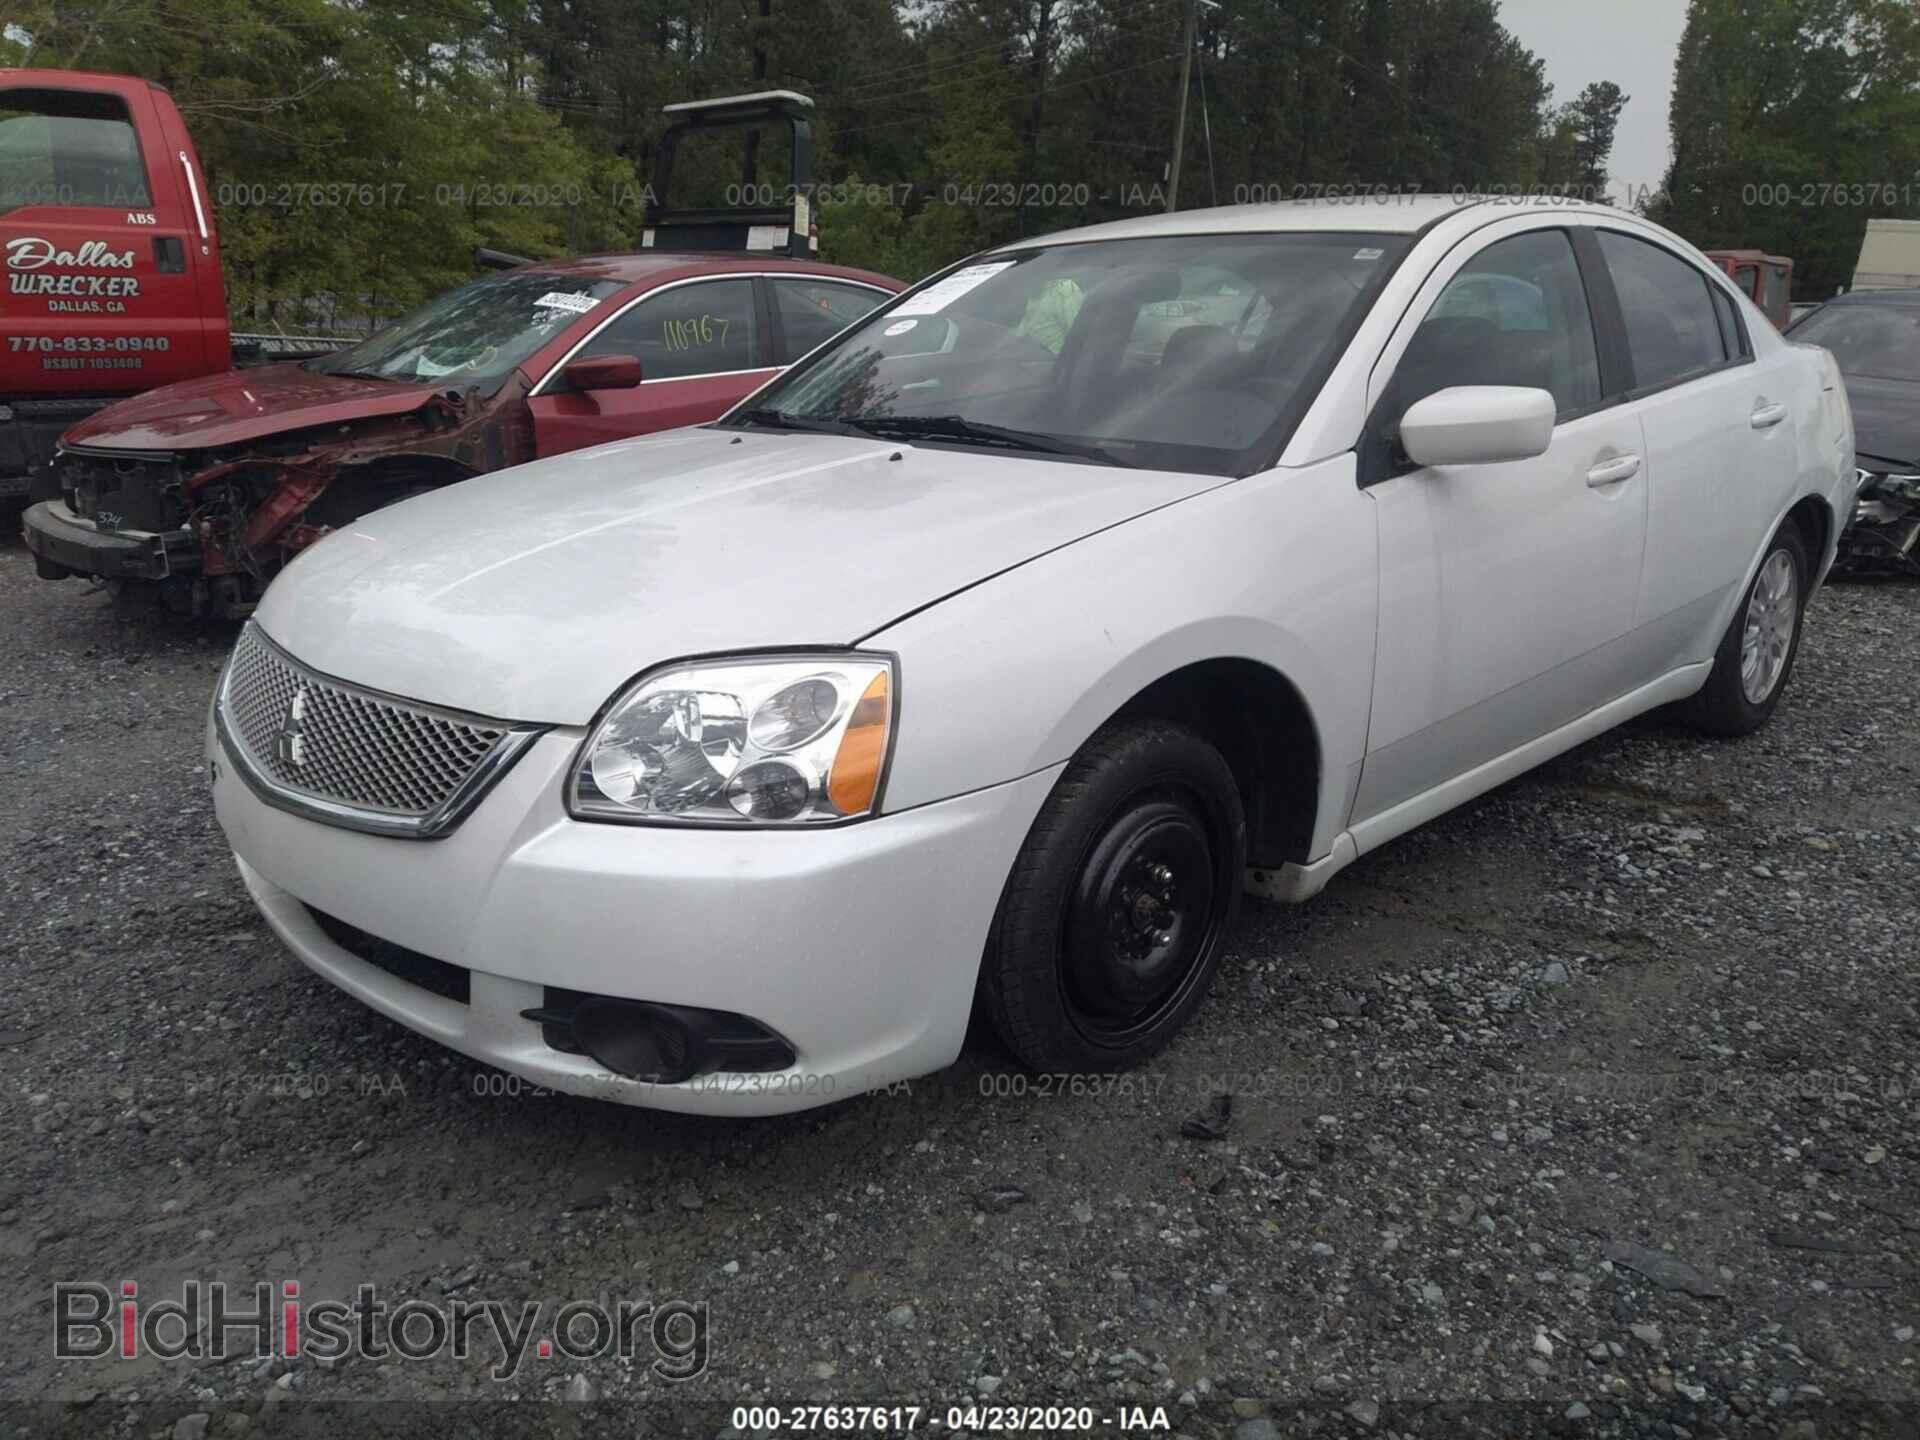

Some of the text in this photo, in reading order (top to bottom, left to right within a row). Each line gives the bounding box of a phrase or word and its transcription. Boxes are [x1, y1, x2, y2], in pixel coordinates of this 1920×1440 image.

[127, 213, 156, 224] ABS
[6, 237, 136, 269] Dallas
[8, 273, 140, 296] WRECKER
[106, 301, 125, 312] GA
[8, 336, 168, 351] 770-833-0940
